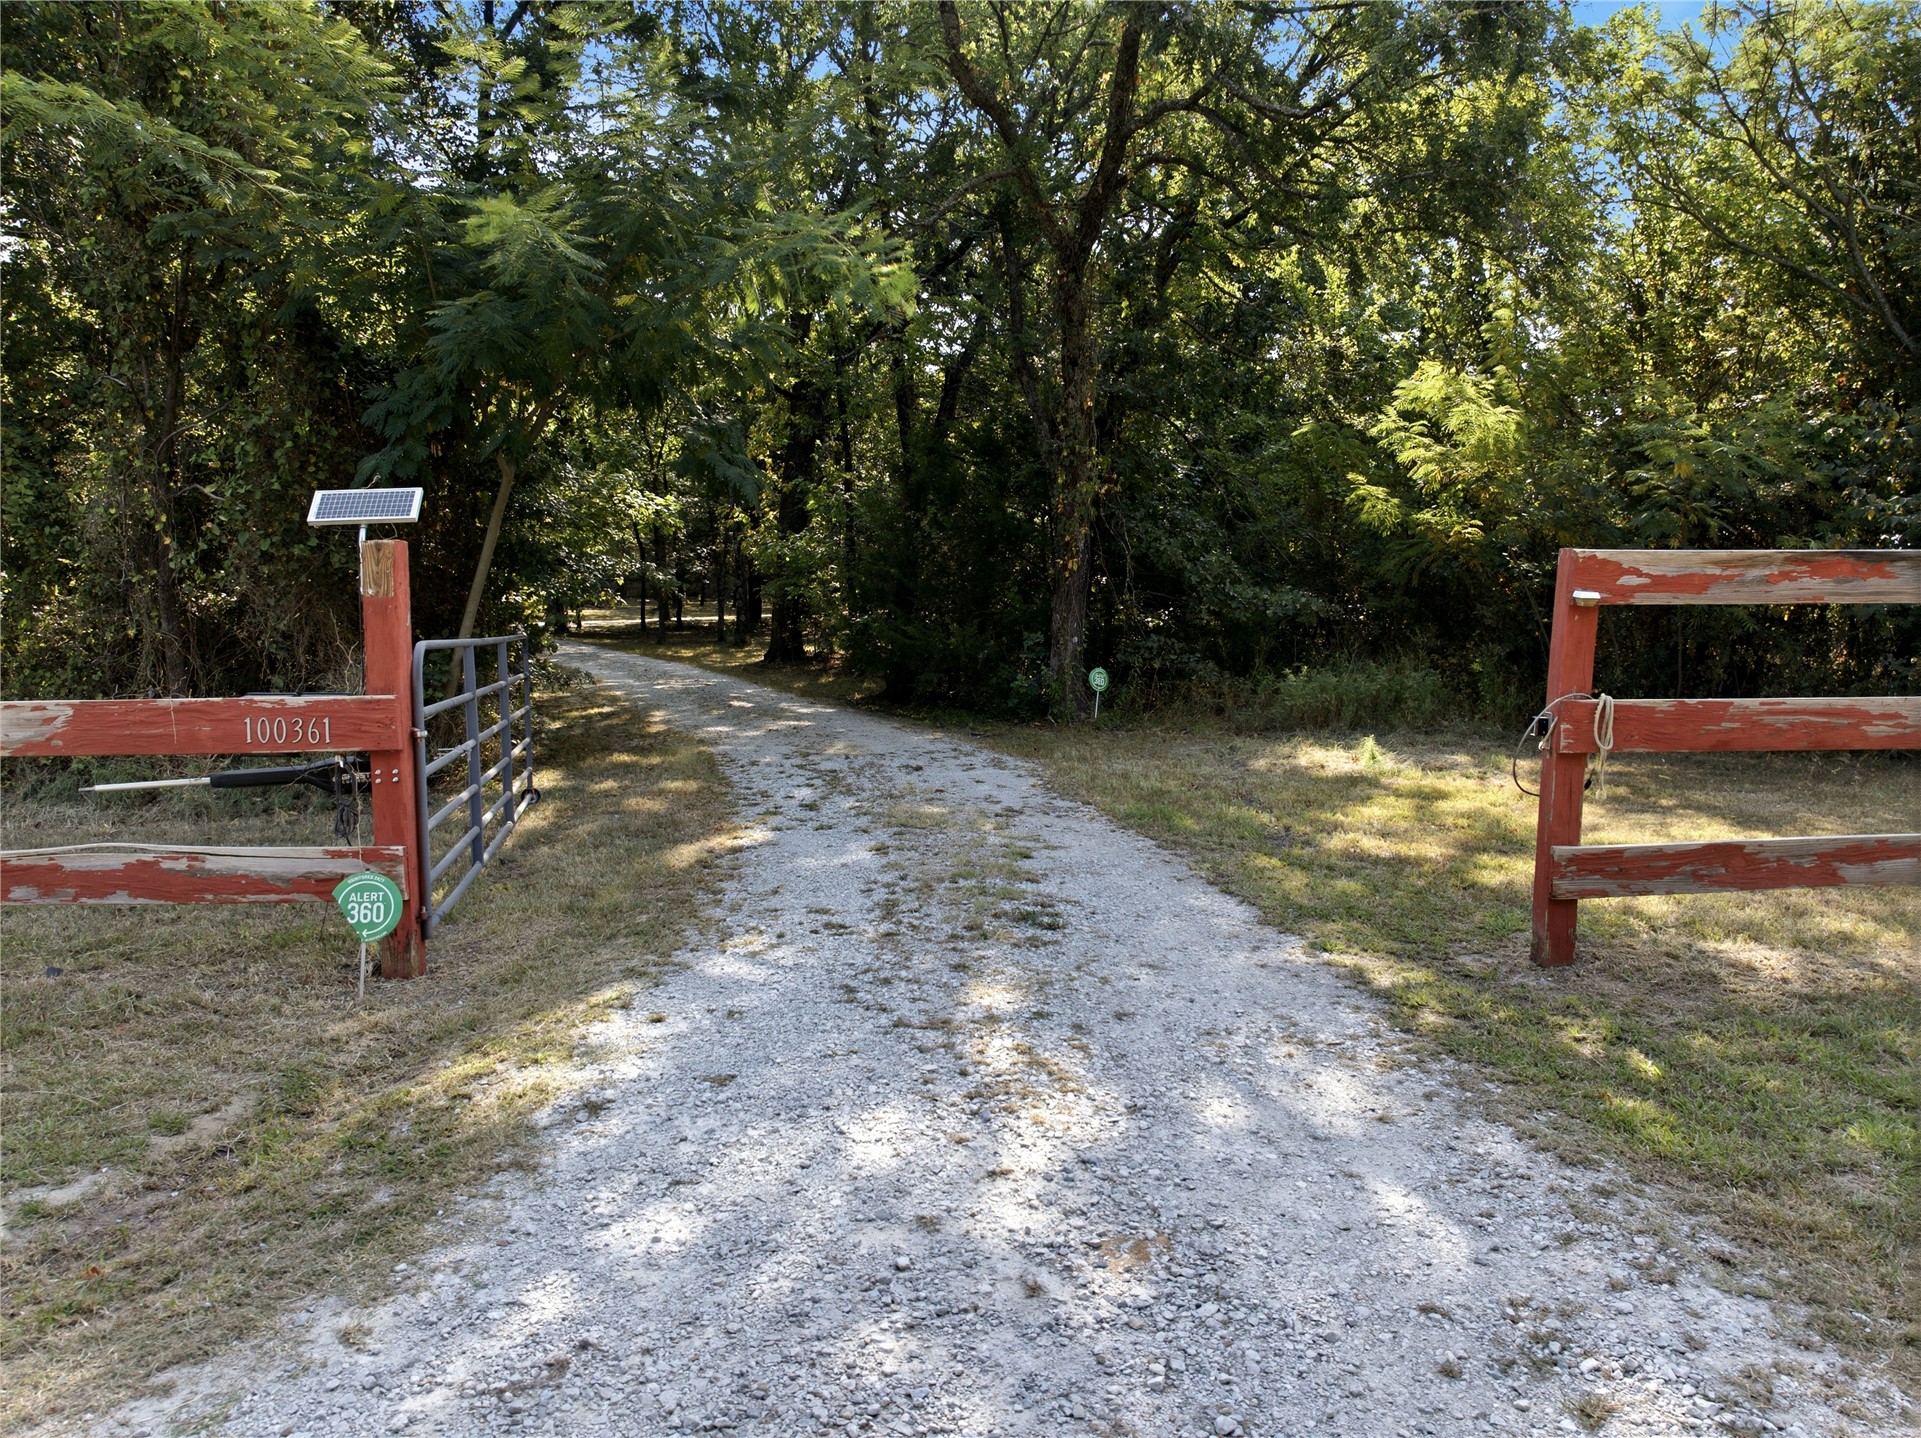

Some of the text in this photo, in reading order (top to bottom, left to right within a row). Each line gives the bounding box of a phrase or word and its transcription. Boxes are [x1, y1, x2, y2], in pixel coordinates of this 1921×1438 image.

[244, 717, 331, 744] 100361
[348, 892, 384, 902] ALERT
[347, 902, 384, 924] 360
